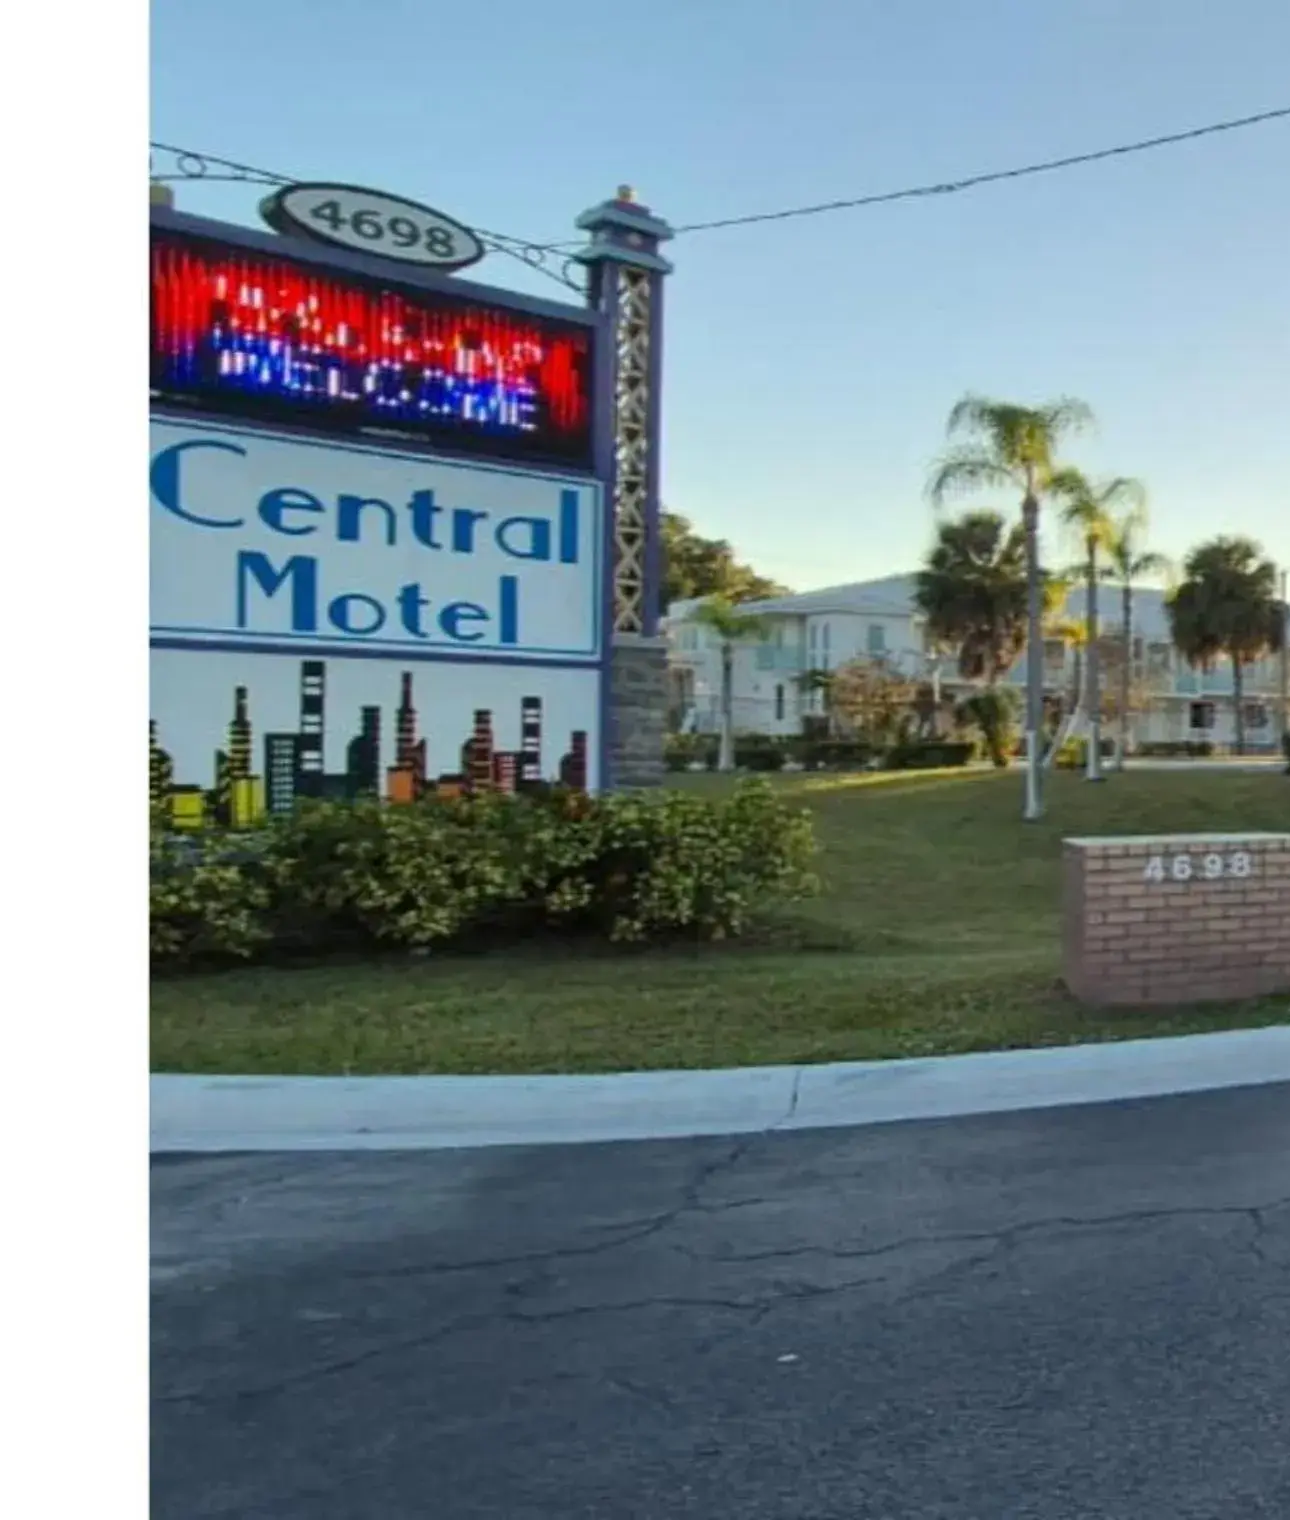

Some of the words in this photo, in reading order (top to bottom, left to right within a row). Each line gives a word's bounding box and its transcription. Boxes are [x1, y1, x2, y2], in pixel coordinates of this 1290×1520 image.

[309, 199, 456, 258] 4698
[150, 440, 579, 564] Central
[237, 550, 518, 645] Motel
[1143, 851, 1251, 881] 4698
